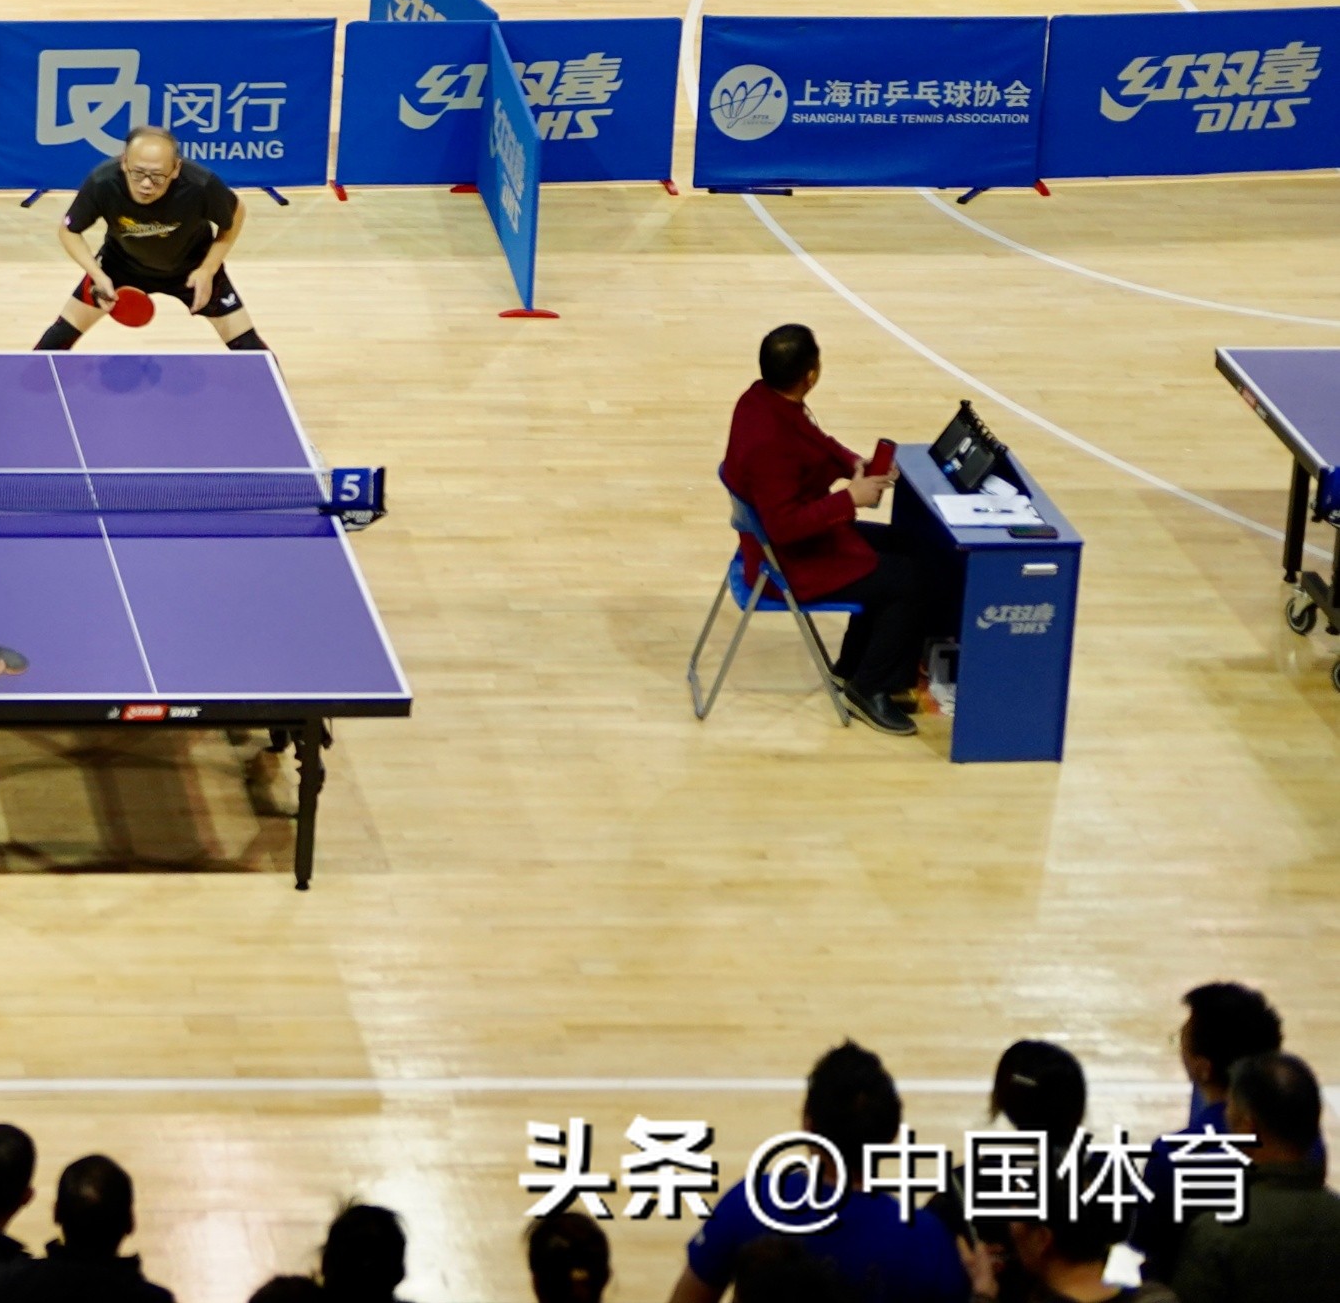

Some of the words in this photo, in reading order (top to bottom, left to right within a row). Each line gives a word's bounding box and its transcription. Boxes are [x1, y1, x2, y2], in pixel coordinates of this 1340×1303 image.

[793, 79, 1032, 108] 上海市乒乓球协会
[1099, 40, 1323, 123] 红双喜
[162, 82, 287, 134] 闵行
[538, 107, 615, 141] HS
[792, 112, 856, 124] SHANGHAI
[858, 112, 898, 124] TABLE
[900, 113, 945, 124] TENNIS
[946, 112, 1030, 124] ASSOCIATION
[1194, 96, 1312, 134] DHS
[339, 474, 361, 502] 5
